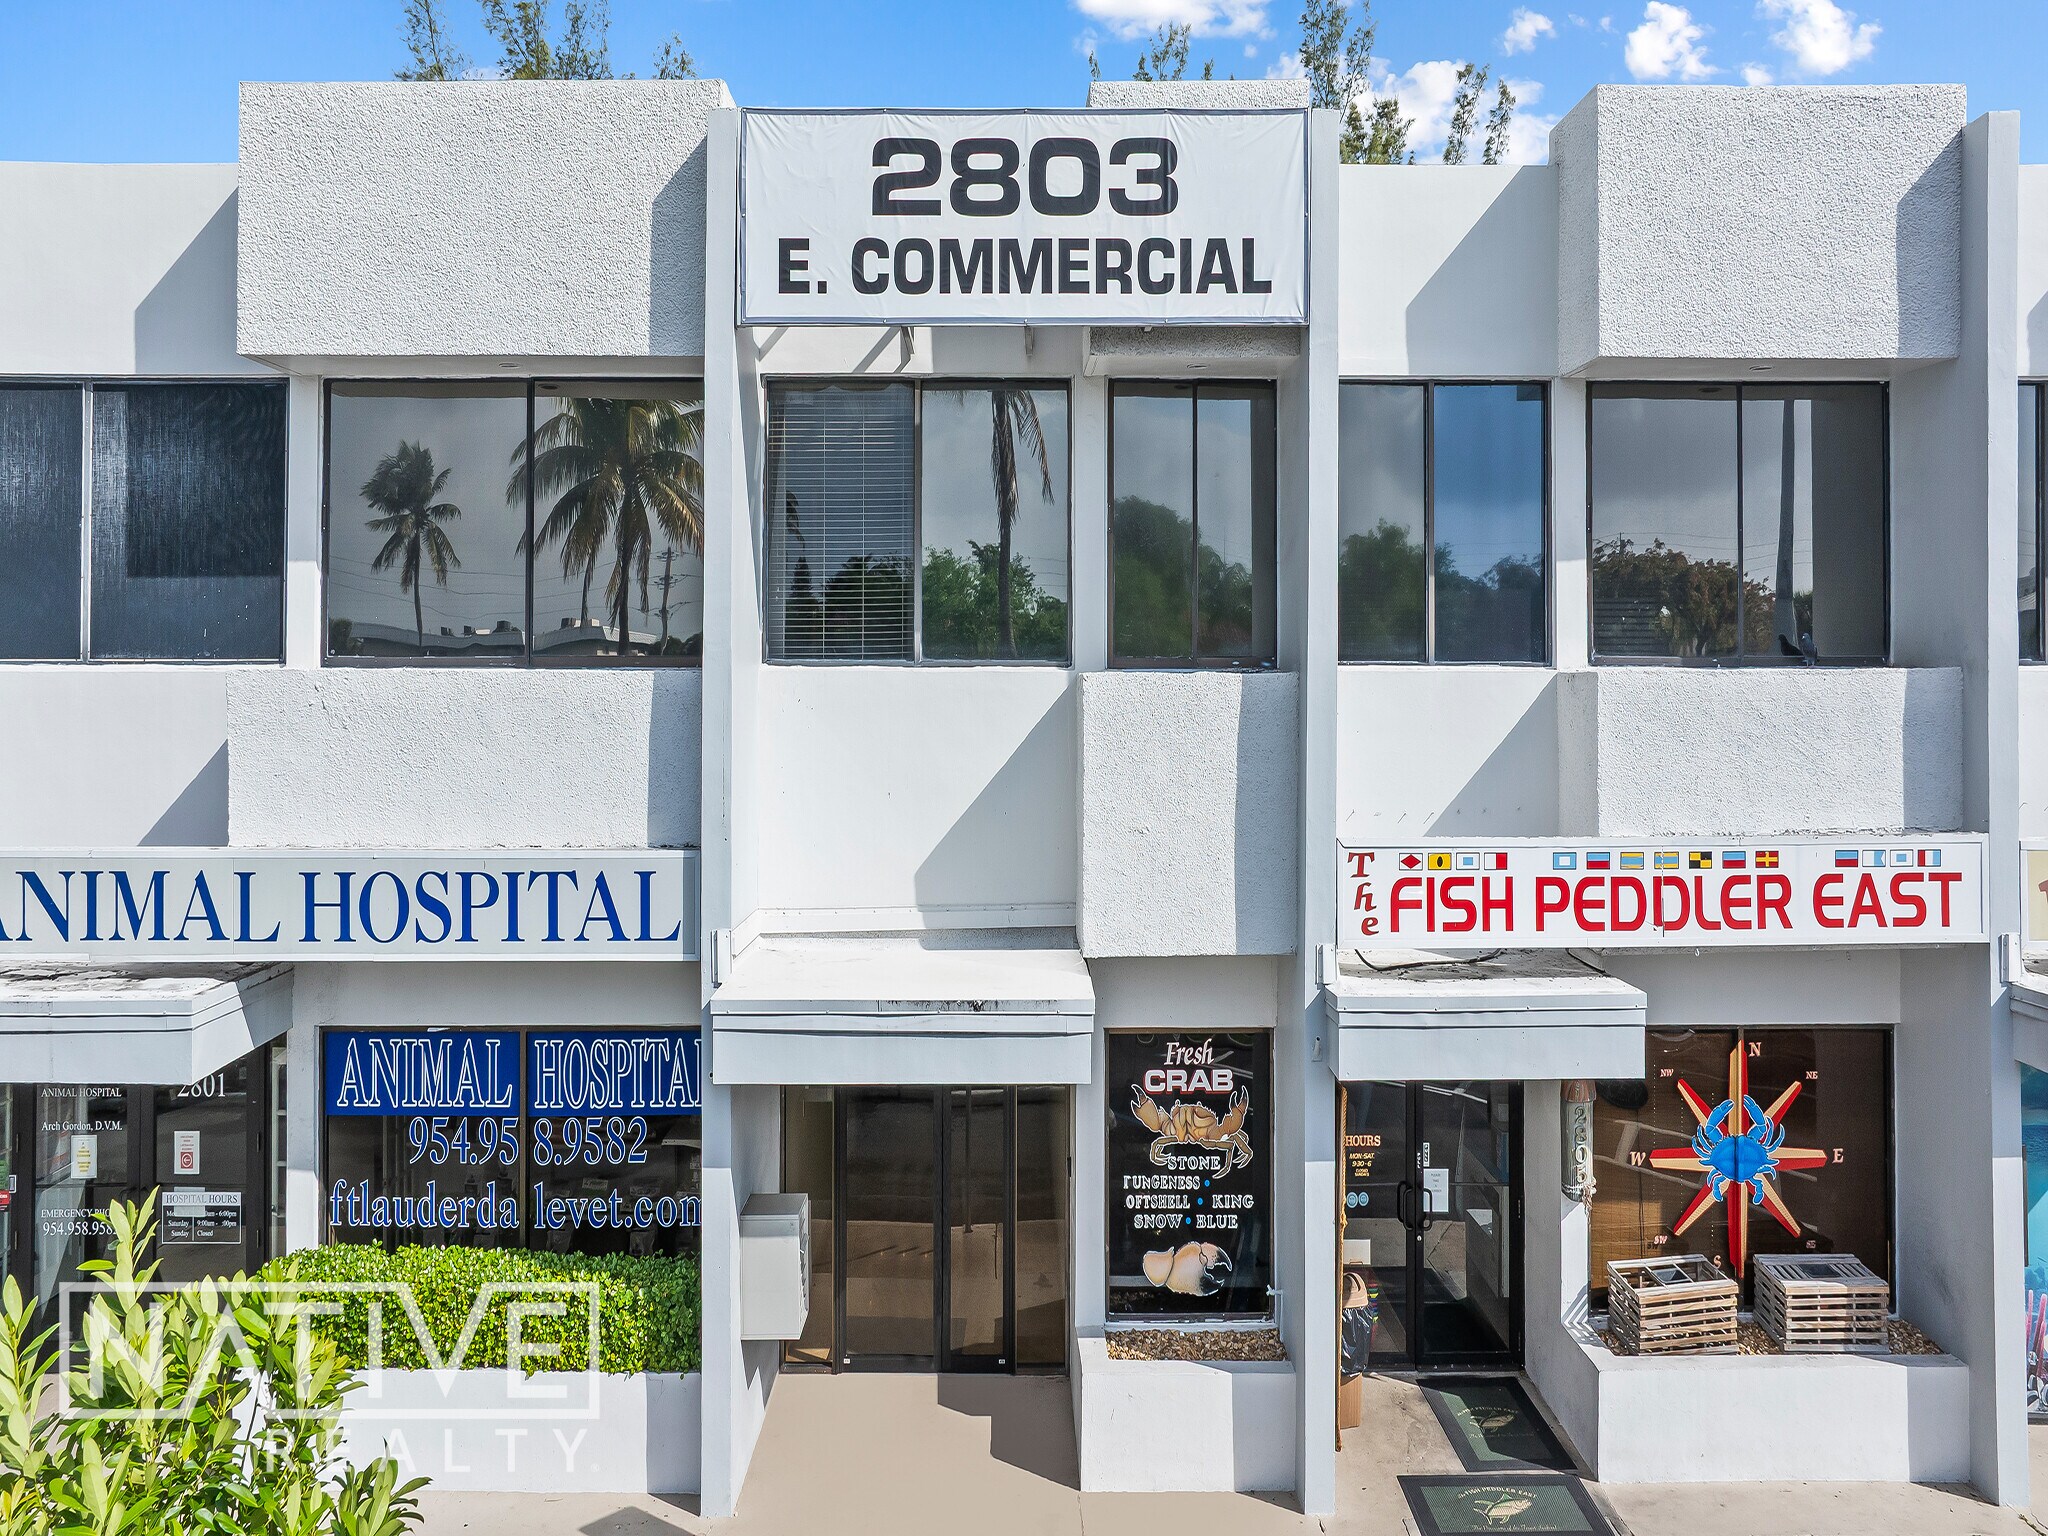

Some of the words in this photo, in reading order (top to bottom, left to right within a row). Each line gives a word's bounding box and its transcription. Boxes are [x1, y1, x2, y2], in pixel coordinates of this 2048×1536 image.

[871, 137, 1179, 216] 2803
[778, 238, 828, 294] E.
[851, 237, 1272, 295] COMMERCIAL
[1347, 851, 1379, 936] The
[0, 870, 281, 943] NIMAL
[299, 870, 682, 944] HOSPITAL
[1390, 875, 1515, 933] FISH
[1535, 874, 1794, 932] PEDDLER
[1812, 872, 1964, 929] EAST
[1163, 1038, 1214, 1067] Fresh
[1748, 1042, 1762, 1057] N
[336, 1038, 513, 1108] ANIMAL
[1660, 1068, 1674, 1077] NW
[1805, 1071, 1818, 1080] NE
[1144, 1068, 1234, 1094] CRAB
[41, 1087, 77, 1098] ANIMAL
[79, 1087, 122, 1097] HOSPITAL
[41, 1121, 60, 1131] Arch
[62, 1120, 93, 1132] Gordon,
[95, 1120, 123, 1131] D.V.M.
[1345, 1134, 1381, 1147] HOURS
[1167, 1155, 1221, 1170] STONE
[1630, 1152, 1647, 1167] W
[1832, 1148, 1844, 1163] E
[166, 1194, 207, 1204] HOSPITAL
[209, 1194, 238, 1204] HOURS
[1212, 1194, 1255, 1209] KING
[41, 1208, 93, 1218] EMERGENCY
[168, 1220, 189, 1229] Saturday
[1133, 1213, 1183, 1229] SNOW
[1196, 1214, 1238, 1229] BLUE
[171, 1230, 189, 1238] Sunday
